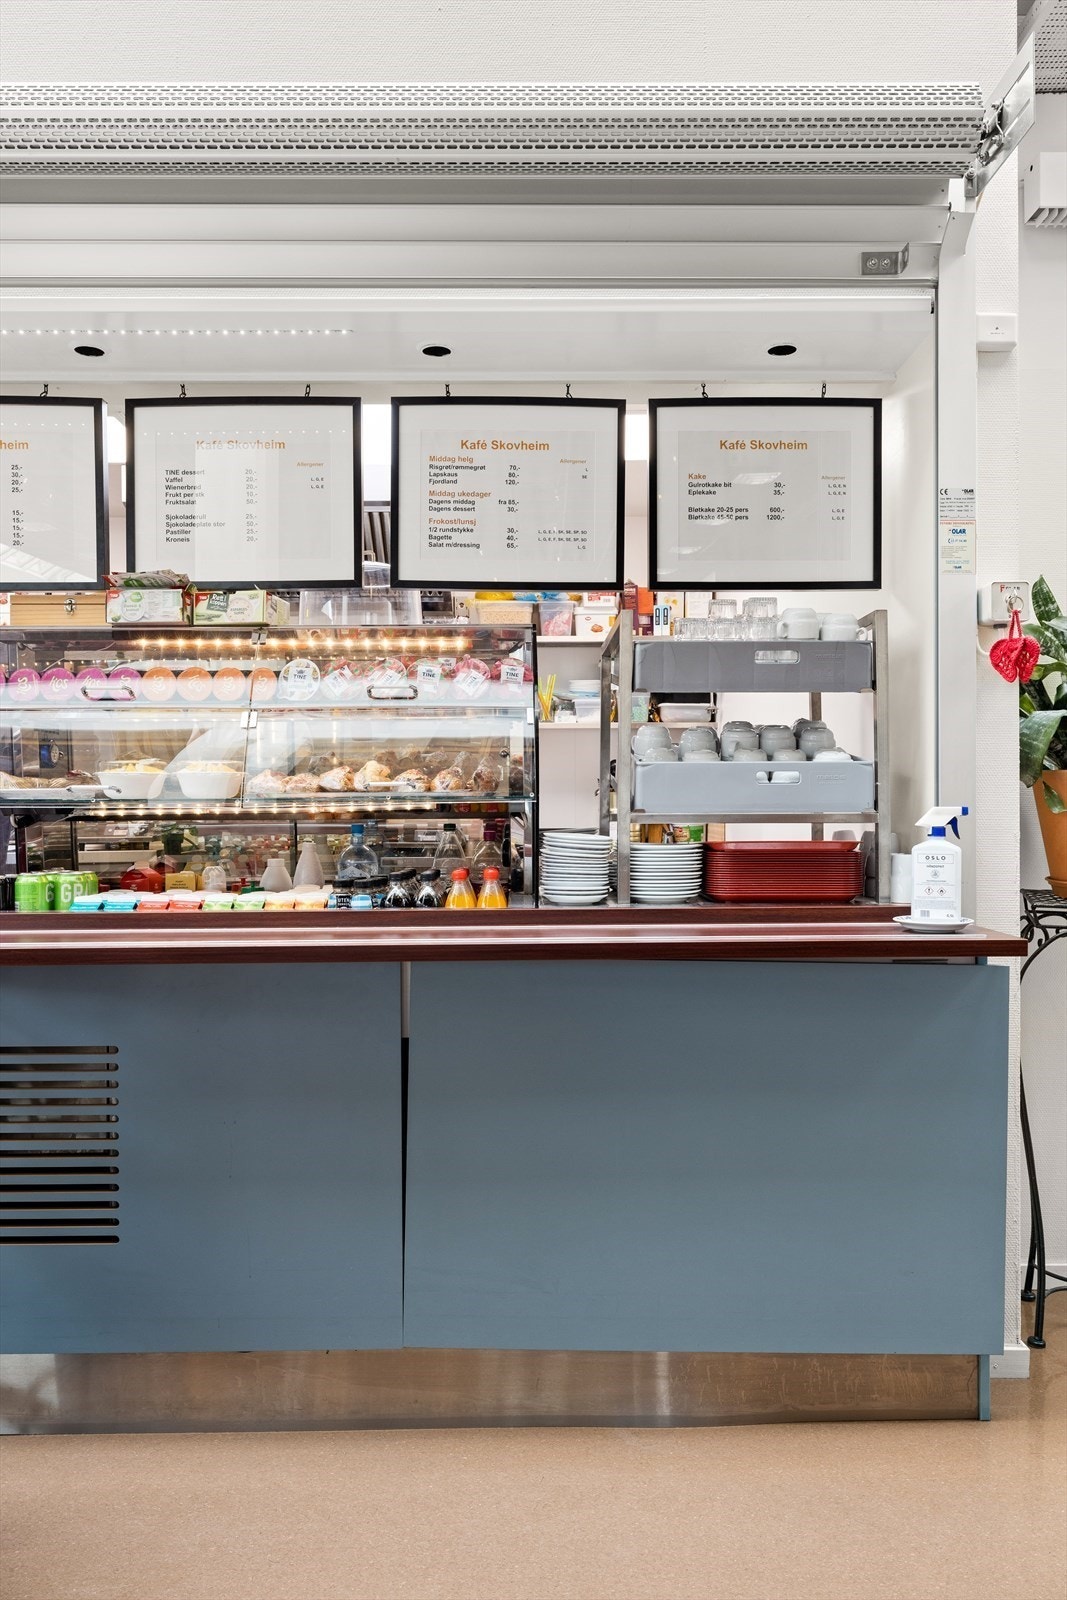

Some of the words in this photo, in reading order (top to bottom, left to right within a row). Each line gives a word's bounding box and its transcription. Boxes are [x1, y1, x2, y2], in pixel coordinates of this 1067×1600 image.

[196, 440, 223, 450] Kafé
[227, 440, 286, 450] Skovheim
[461, 440, 487, 450] Kafé
[491, 440, 549, 451] Skovheim
[720, 440, 746, 450] Kafé
[750, 440, 808, 450] Skovheim
